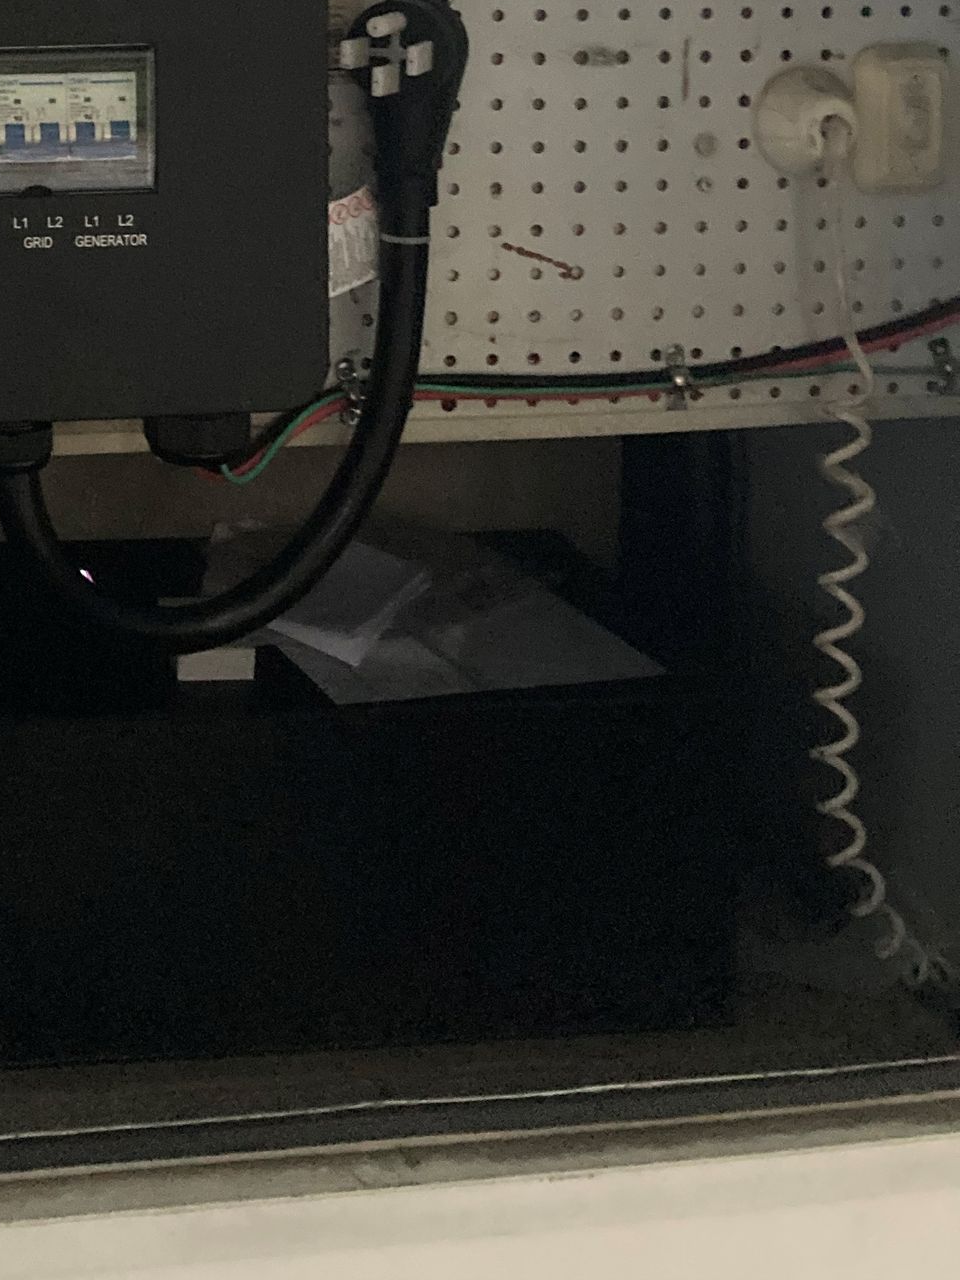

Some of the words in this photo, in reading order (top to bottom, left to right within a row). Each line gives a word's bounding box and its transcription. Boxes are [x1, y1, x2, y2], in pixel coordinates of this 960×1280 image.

[13, 217, 29, 229] L1
[47, 216, 64, 228] L2
[84, 215, 100, 227] L1
[118, 214, 134, 226] L2
[23, 236, 54, 249] GRID
[74, 233, 148, 248] GENERATOR
